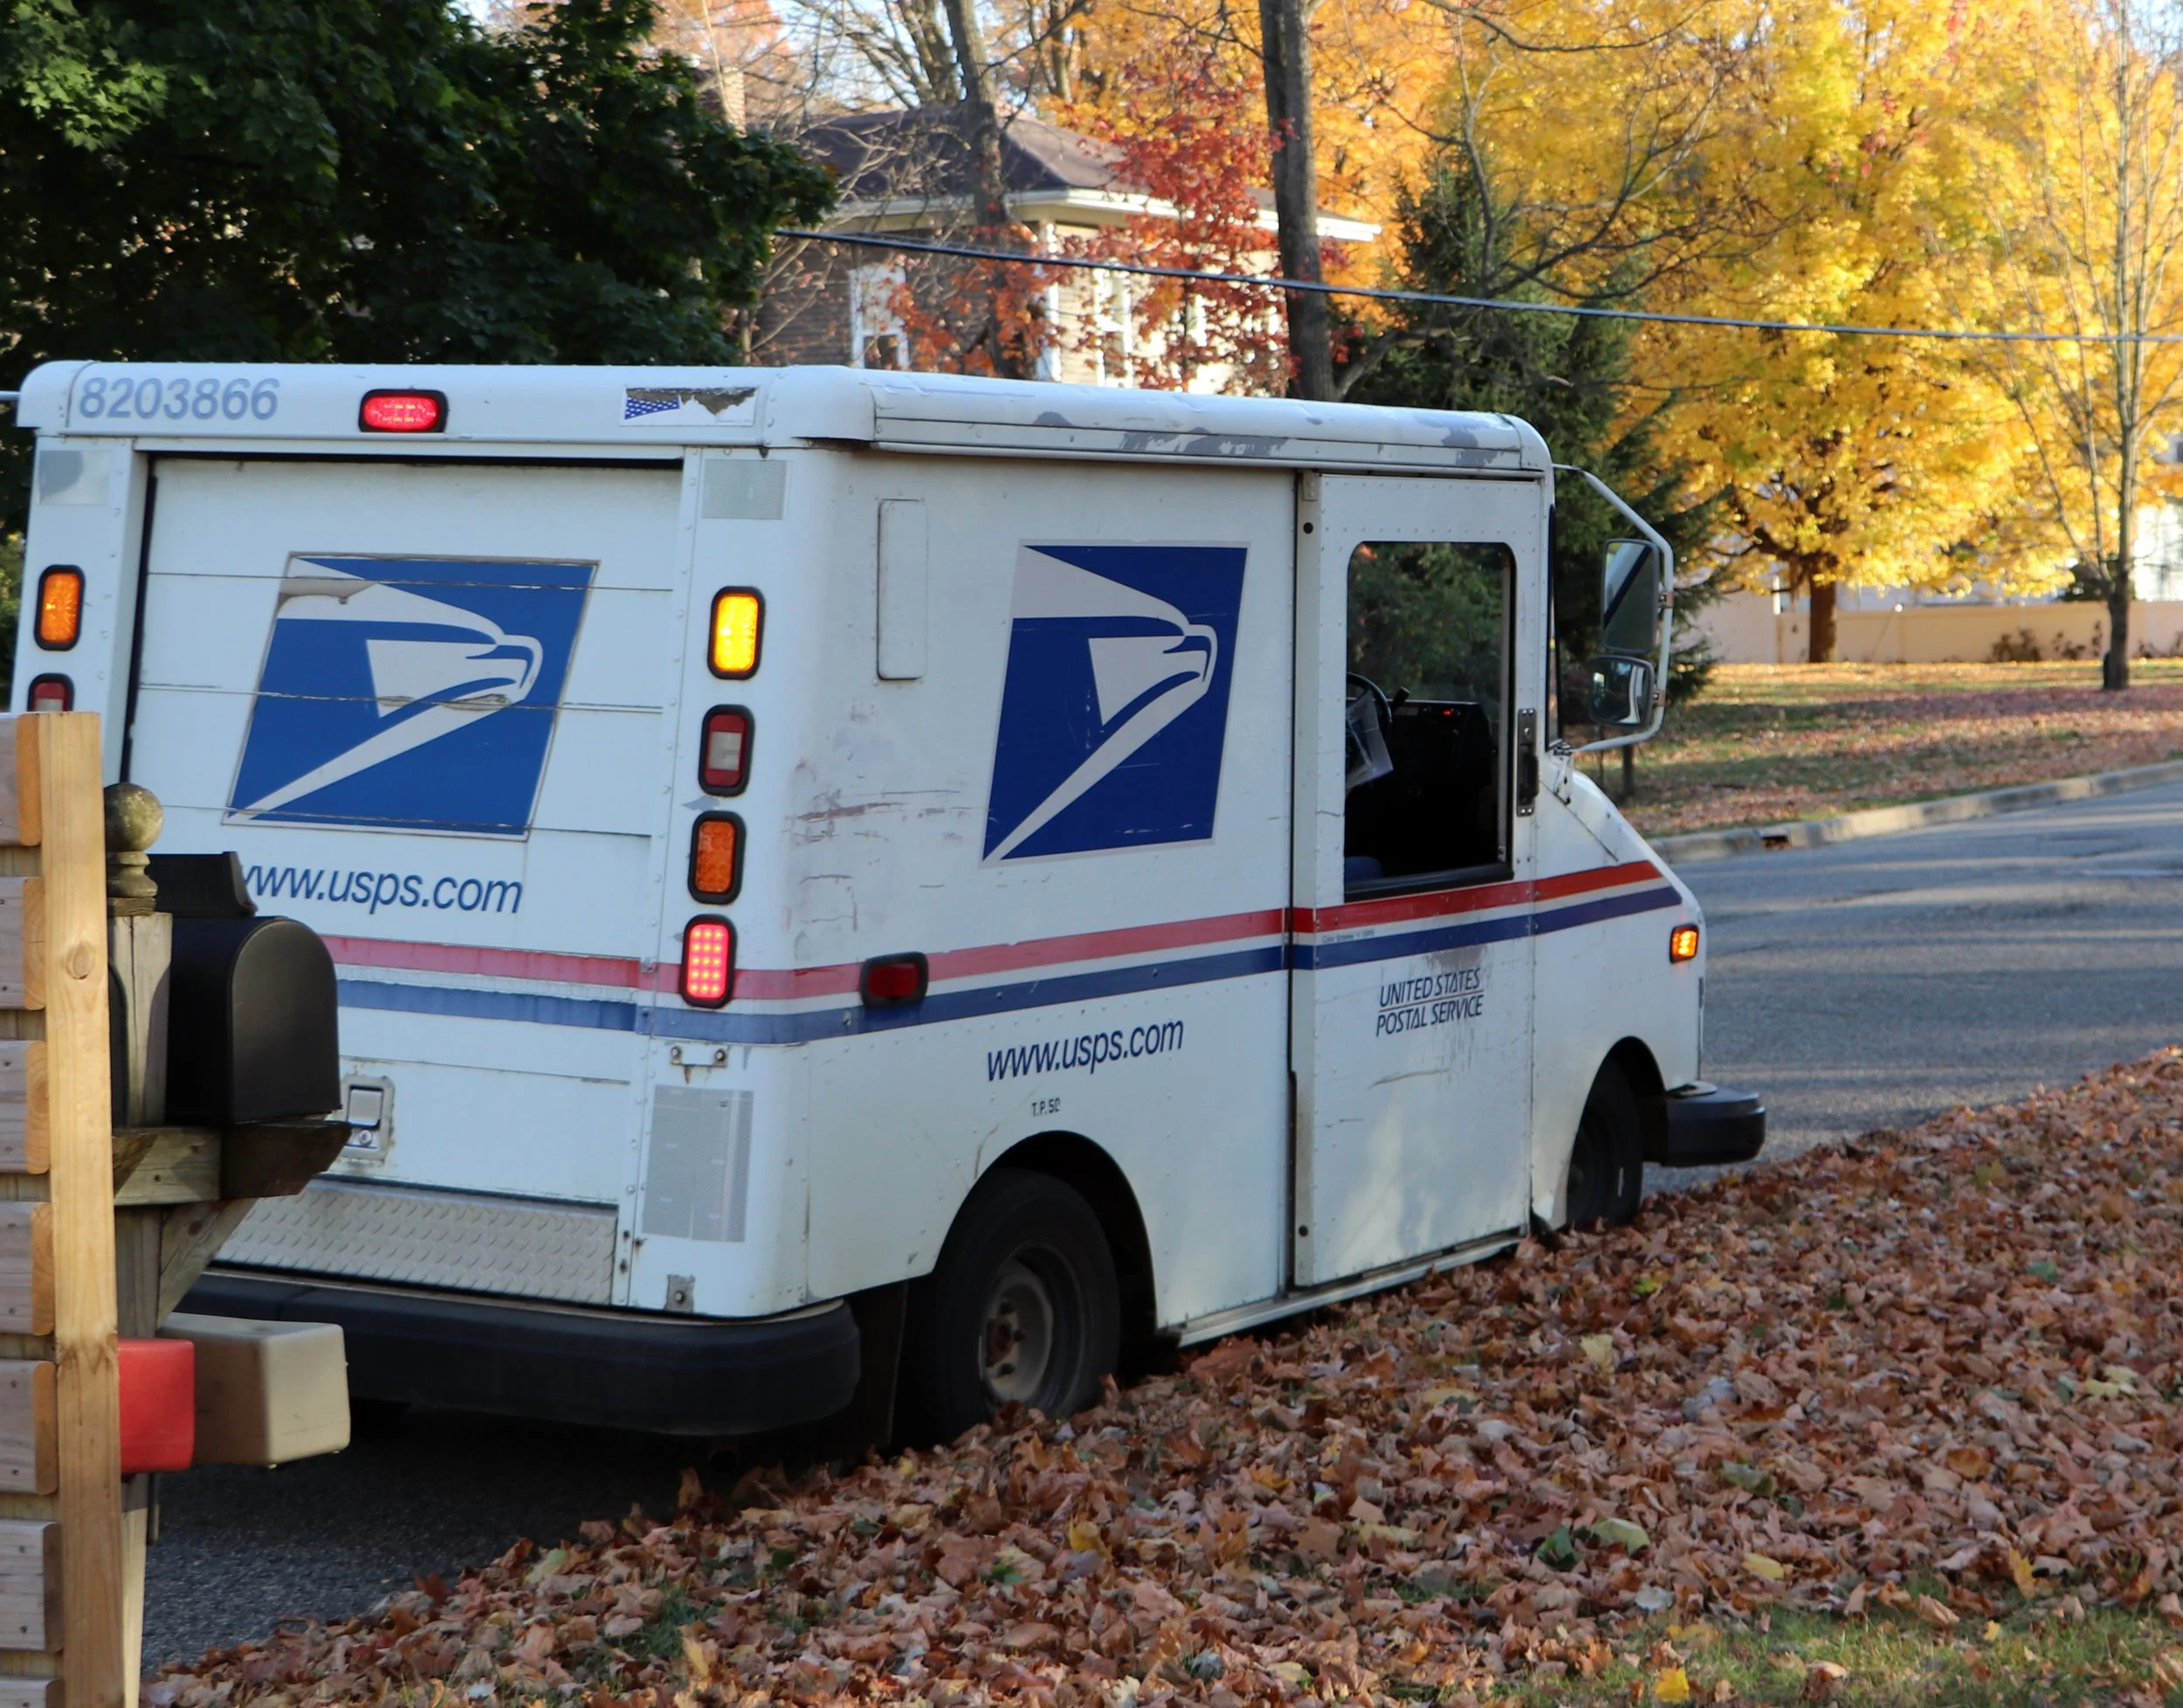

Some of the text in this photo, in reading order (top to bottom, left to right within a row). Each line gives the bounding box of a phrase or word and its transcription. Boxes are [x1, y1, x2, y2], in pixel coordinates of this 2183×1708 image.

[79, 377, 280, 420] 8203866
[241, 864, 523, 914] ww.usps.com
[1380, 968, 1481, 1007] UNITED STATES
[1376, 995, 1484, 1037] POSTAL SERVICE
[988, 1020, 1184, 1082] www.usps.com
